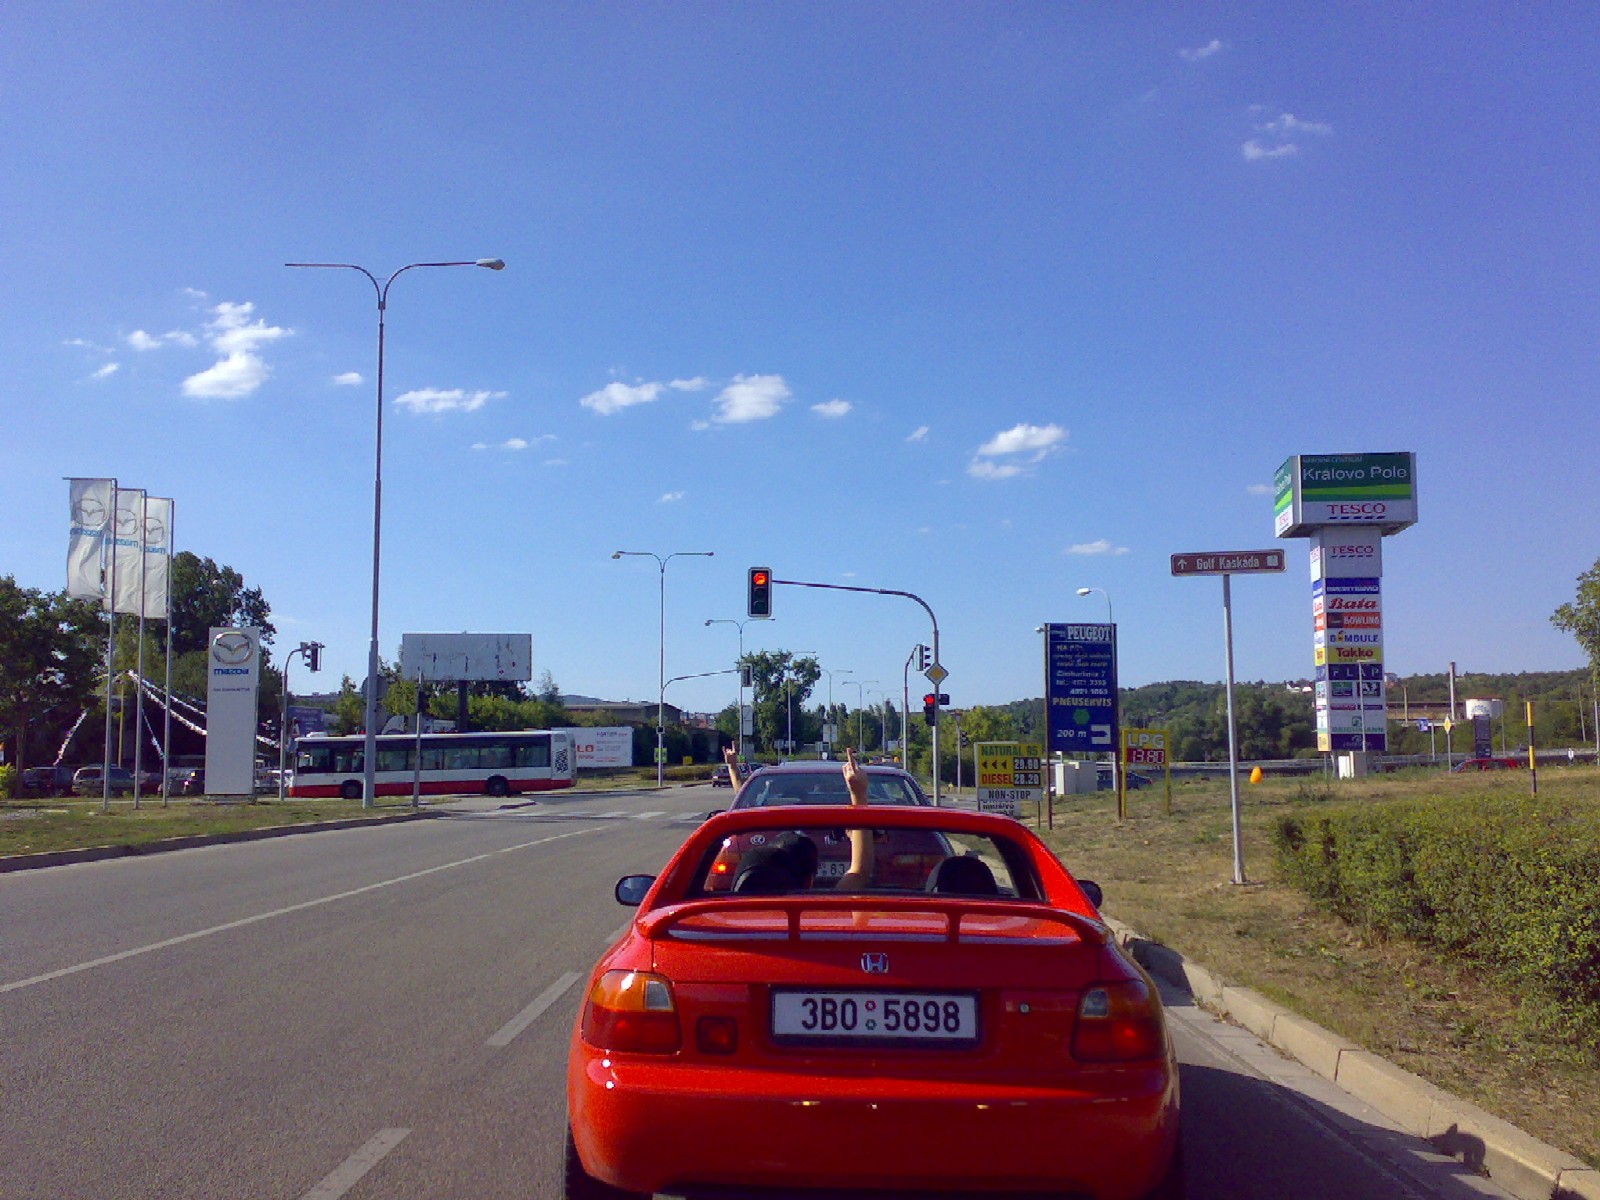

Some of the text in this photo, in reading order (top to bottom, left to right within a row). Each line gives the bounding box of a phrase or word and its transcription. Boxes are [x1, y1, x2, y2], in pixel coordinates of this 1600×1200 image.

[1370, 465, 1408, 479] Pole
[1326, 502, 1386, 515] TESCO
[1330, 545, 1374, 554] TESCO
[1196, 557, 1216, 570] Golf
[1343, 615, 1380, 625] BOWLING
[1067, 625, 1111, 641] PEUGEOT
[1335, 647, 1374, 658] Takko
[1052, 697, 1112, 707] PNEUSERVIS
[1056, 729, 1075, 738] 200
[1127, 733, 1165, 747] LPG
[981, 745, 1021, 756] NATURAL
[981, 773, 1039, 785] DIESEL 28.20
[988, 790, 1031, 800] NON-STOP
[884, 1000, 961, 1033] 5898
